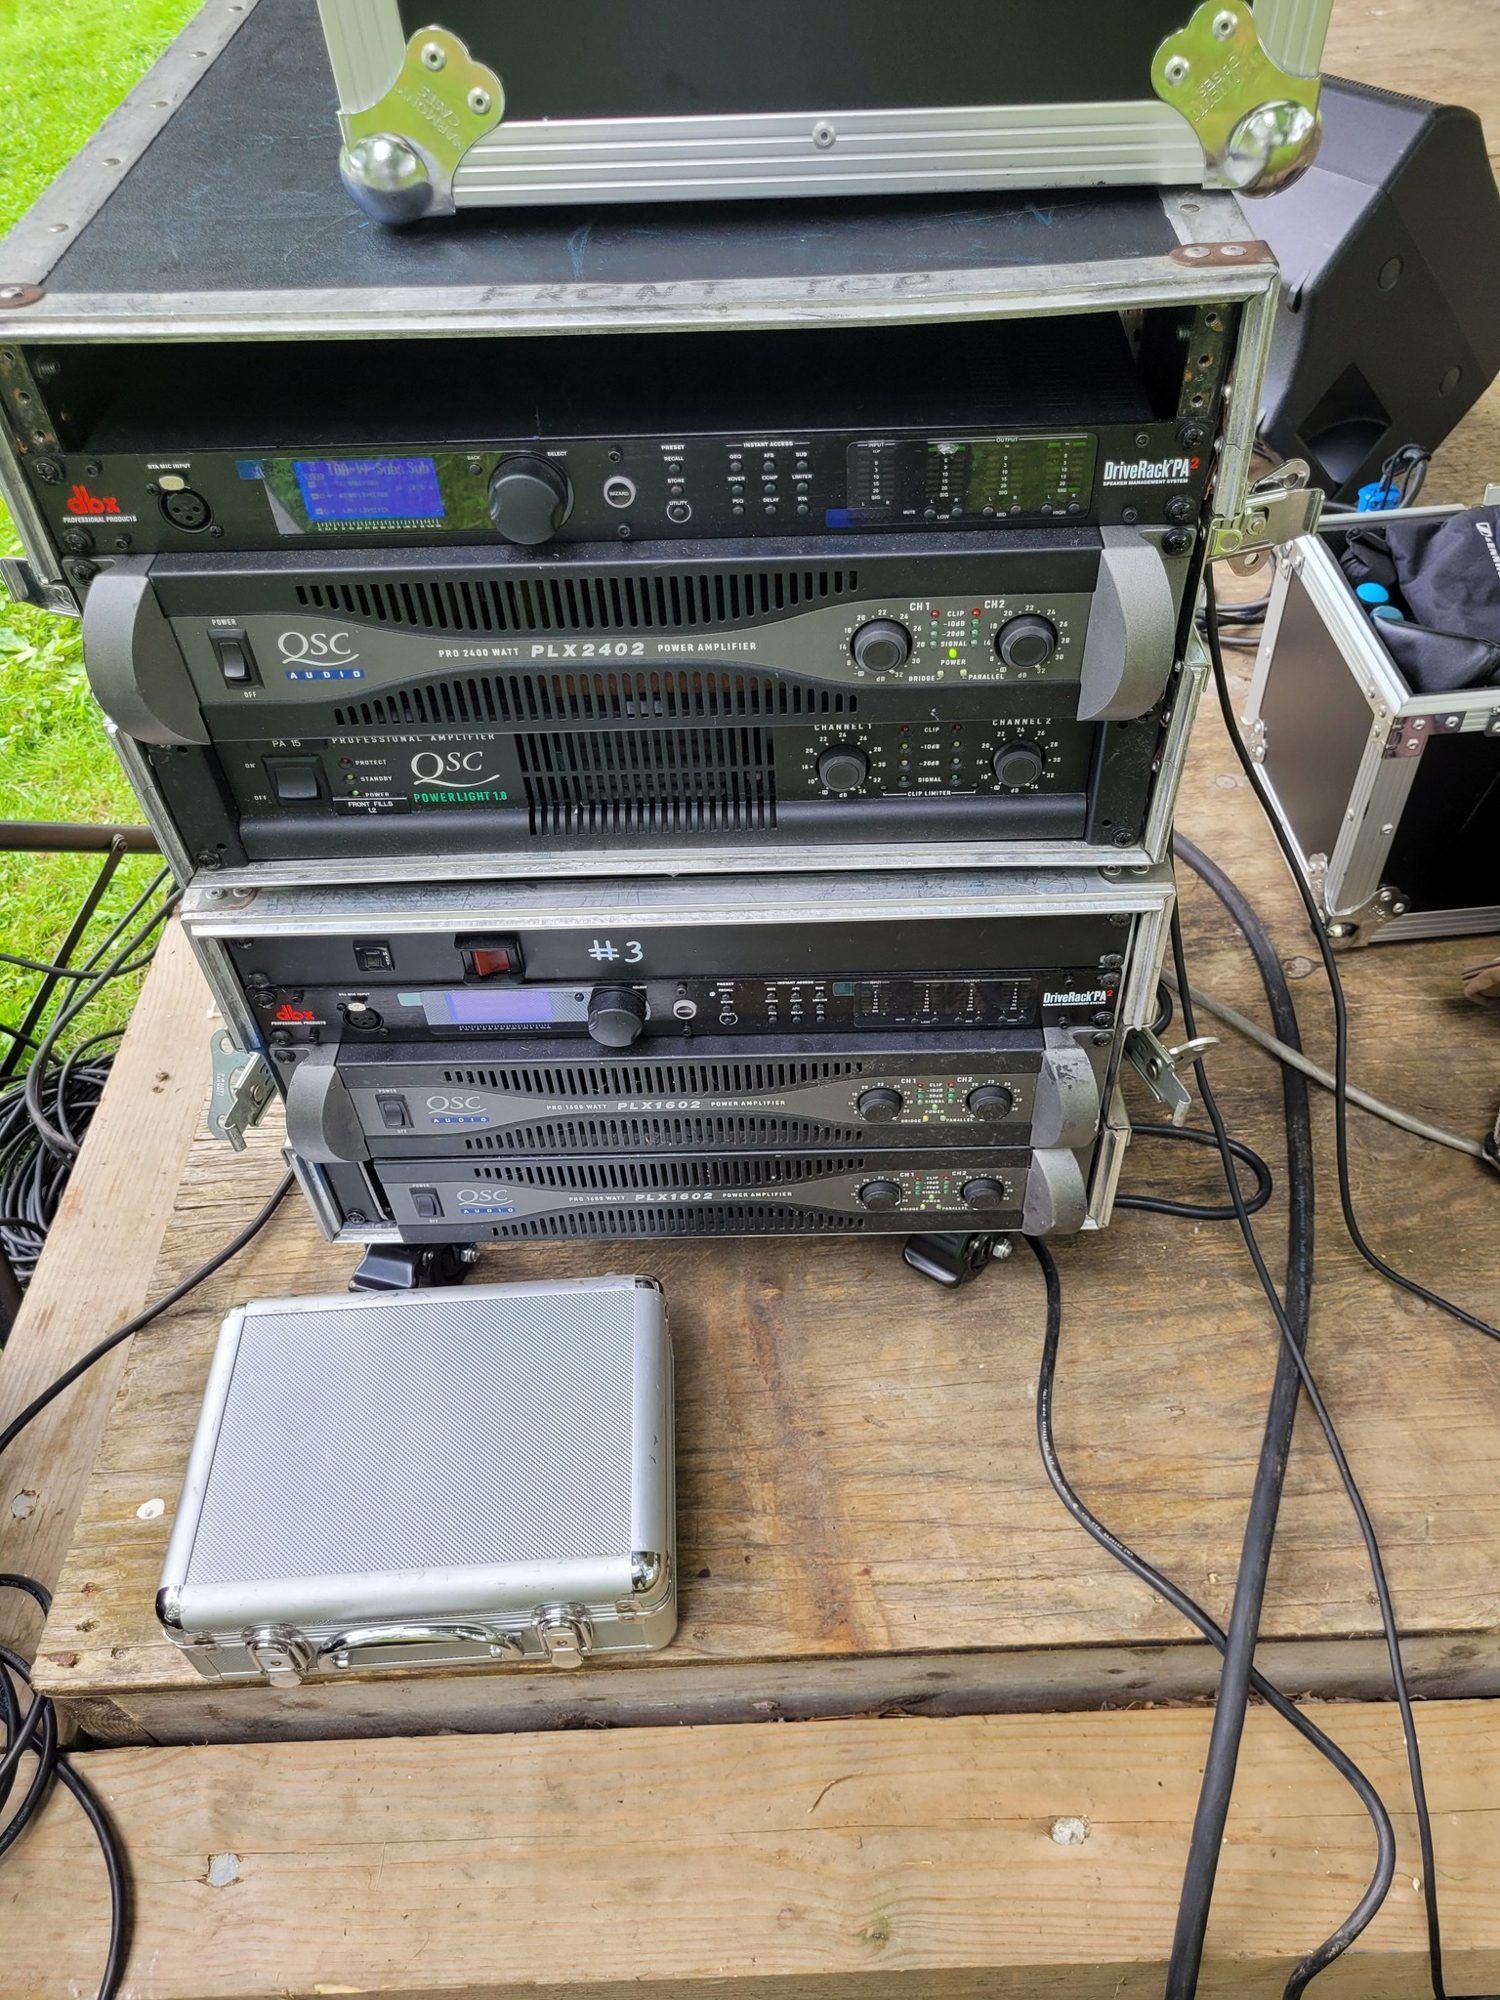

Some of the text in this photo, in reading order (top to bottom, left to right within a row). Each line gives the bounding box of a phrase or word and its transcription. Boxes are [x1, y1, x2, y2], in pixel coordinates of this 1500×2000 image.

[67, 484, 120, 514] dbx
[211, 618, 237, 626] POWER
[278, 632, 360, 667] QSC
[438, 641, 757, 658] PRO 2400 WATT PLX2402 POWER AMPLIFIER
[290, 670, 361, 679] AUDIO
[992, 718, 1042, 726] CHANNEL
[272, 739, 302, 748] PA 15
[332, 734, 496, 744] PROFESSIONAL AMPLIFIER
[411, 751, 500, 788] QSC
[413, 791, 490, 803] POWERLIGHT
[276, 1004, 315, 1021] dbx
[426, 1095, 487, 1116] QSC
[617, 1100, 701, 1110] PLX1602
[456, 1189, 514, 1207] QSC
[635, 1192, 713, 1201] PLX1602
